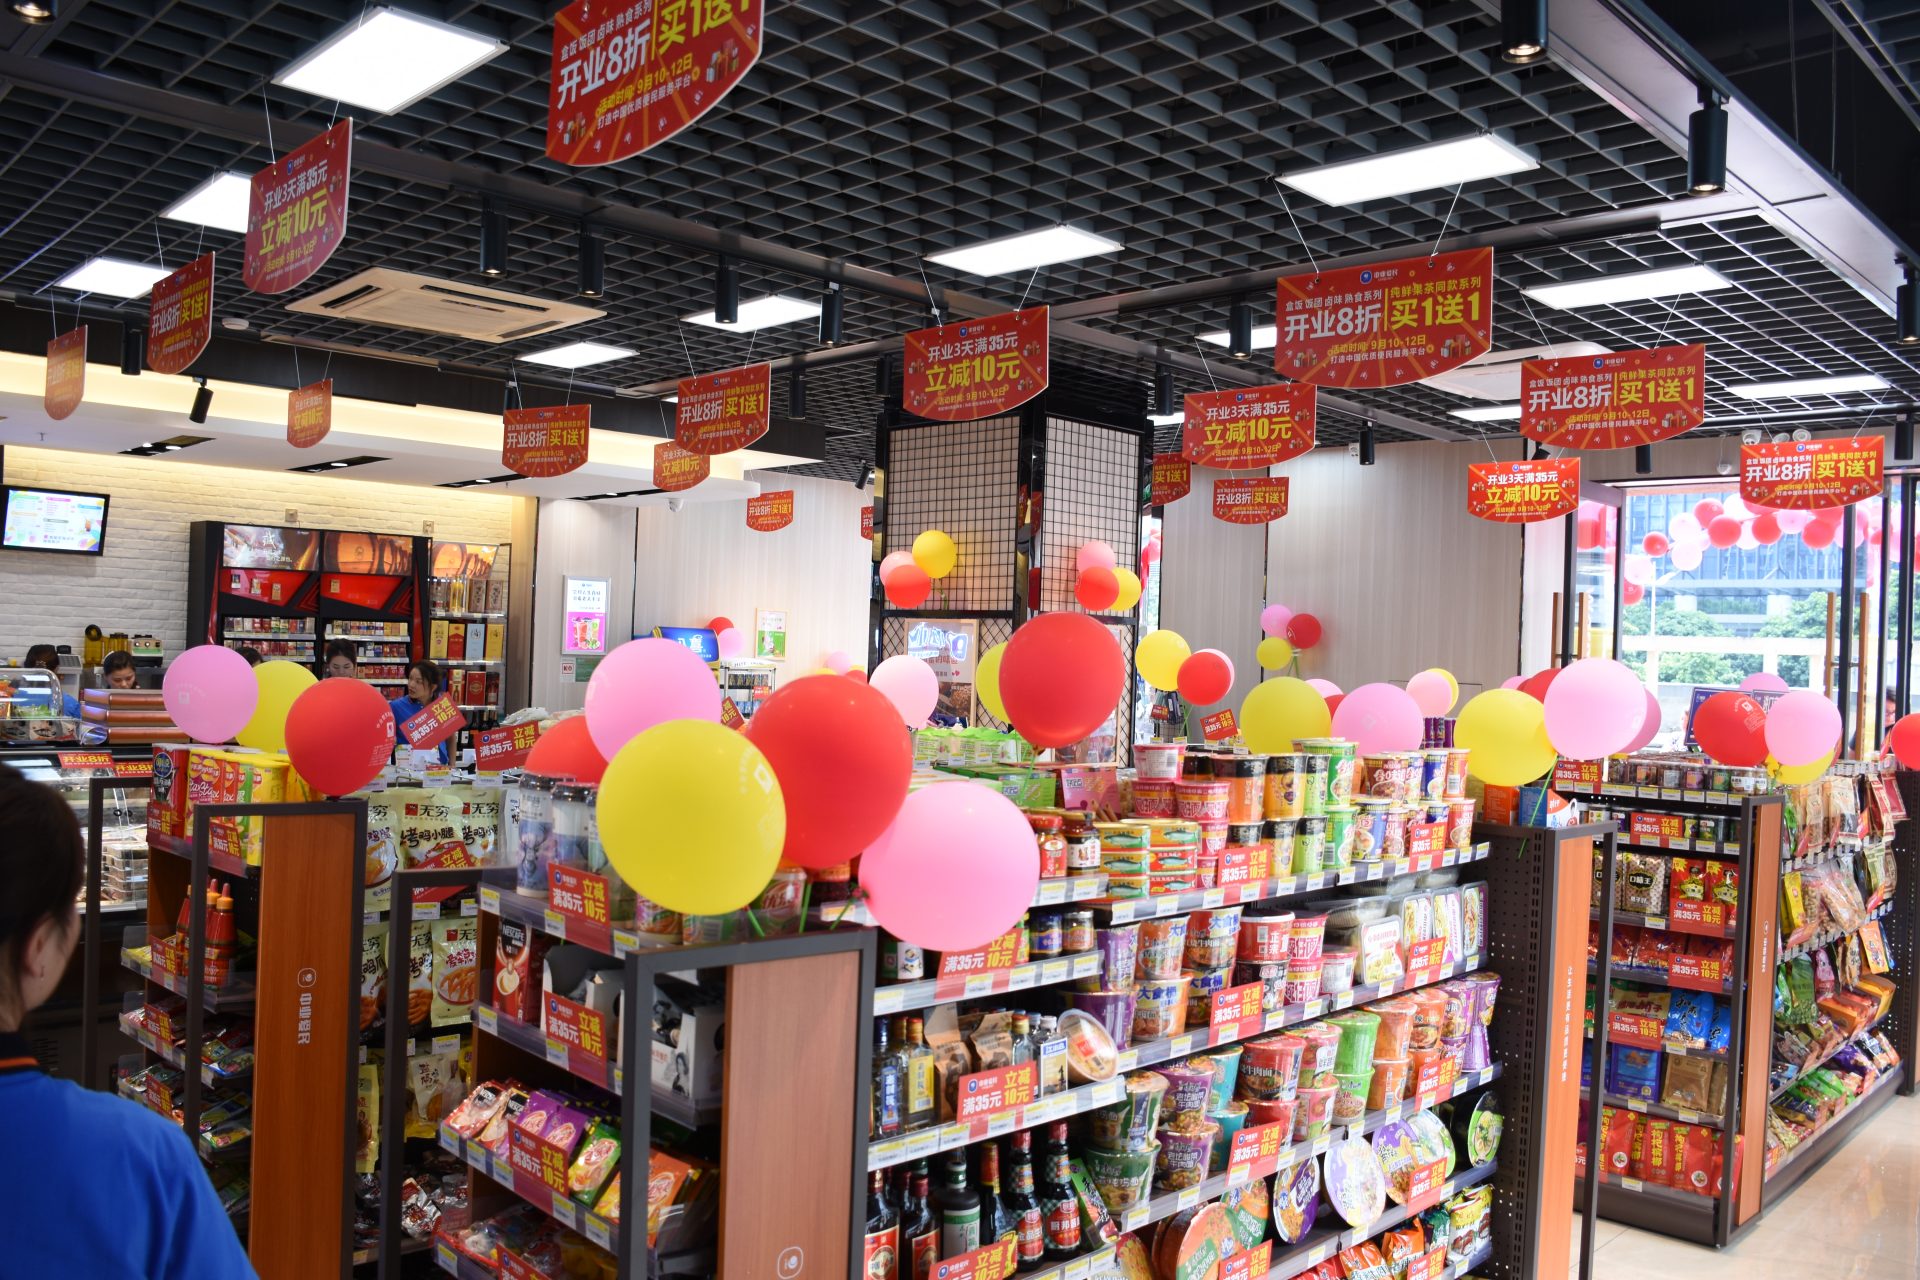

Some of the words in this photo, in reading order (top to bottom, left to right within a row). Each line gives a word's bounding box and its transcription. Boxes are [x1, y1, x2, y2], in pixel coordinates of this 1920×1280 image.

[561, 41, 577, 62] 盒饭
[579, 30, 595, 50] 饭团
[597, 20, 614, 40] 卤味
[557, 19, 651, 110] 开业8折
[637, 53, 693, 94] 9月10-12日
[597, 75, 691, 130] 打造中国优质便民服务平台
[264, 159, 328, 215] 开业3天满35元
[259, 188, 328, 256] 立减10元
[1390, 276, 1481, 298] 纯鲜果茶同款系列
[182, 291, 208, 325] 买1送1
[1285, 299, 1303, 311] 盒饭
[1305, 296, 1322, 308] 饭团
[1324, 294, 1343, 307] 卤味
[1344, 289, 1382, 304] 熟食系列
[1391, 292, 1480, 331] 买1送1
[152, 304, 180, 337] 开业8折
[1284, 303, 1382, 343] 开业8折
[928, 332, 1018, 362] 开业3天满35元
[1371, 335, 1426, 350] 9月10-12日
[1330, 348, 1425, 364] 打造中国优质便民服务平台
[925, 352, 1020, 393] 立减10元
[1529, 378, 1545, 388] 盒饭
[1546, 376, 1561, 386] 饭团
[1563, 375, 1578, 386] 卤味
[1580, 373, 1612, 383] 熟食系列
[1619, 365, 1696, 381] 纯鲜果茶同款系列
[966, 387, 1005, 401] 9月10-12日
[1528, 383, 1612, 413] 开业8折
[1620, 377, 1694, 404] 买1送1
[680, 400, 723, 425] 开业8折
[726, 393, 764, 417] 买1送1
[1206, 400, 1290, 421] 开业3天满35元
[1603, 409, 1649, 418] 9月10-12日
[1203, 416, 1292, 445] 立减10元
[1568, 419, 1649, 430] 打造中国优质便民服务平台
[507, 431, 547, 448] 开业8折
[550, 429, 585, 446] 买1送1
[662, 456, 700, 476] 立减10元
[1745, 462, 1811, 482] 开业8折
[1817, 459, 1876, 478] 买1送1
[1155, 469, 1187, 483] 买1送1
[1487, 471, 1558, 485] 开业3天满35元
[1216, 492, 1251, 505] 开业8折
[1254, 492, 1285, 504] 买1送1
[1485, 484, 1559, 504] 立减10元
[749, 505, 771, 516] 开业8折
[772, 504, 791, 514] 买1送1
[432, 697, 451, 716] 立减
[437, 707, 457, 723] 10元
[411, 719, 438, 742] 满35元
[514, 724, 535, 739] 立减
[480, 741, 512, 757] 满35元
[516, 737, 535, 749] 10元
[1556, 769, 1580, 780] 满35元
[1581, 764, 1598, 774] 立减
[1582, 772, 1598, 782] 10元
[420, 804, 450, 817] 无穷
[1634, 823, 1659, 834] 满35元
[1661, 817, 1679, 828] 立减
[1662, 826, 1680, 836] 10元
[1432, 825, 1445, 840] 立减
[1412, 838, 1431, 851] 满35元
[1431, 838, 1442, 851] 10元
[441, 847, 464, 866] 立减
[1249, 850, 1267, 865] 立减
[1221, 866, 1248, 881] 满35元
[1249, 864, 1266, 878] 10元
[583, 879, 604, 899] 立减
[1630, 876, 1651, 885] 口味王
[553, 888, 583, 913] 满35元
[583, 898, 606, 922] 10元
[1674, 909, 1701, 920] 满35元
[1703, 905, 1721, 914] 立减
[1703, 913, 1721, 924] 10元
[989, 932, 1017, 952] 立减
[1430, 940, 1443, 954] 立减
[944, 952, 985, 973] 满35元
[987, 951, 1013, 968] 10元
[1701, 961, 1720, 971] 立减
[1672, 965, 1699, 976] 满35元
[1701, 969, 1720, 980] 10元
[1242, 986, 1261, 1003] 立减
[1214, 1005, 1240, 1024] 满35元
[1242, 1000, 1259, 1016] 10元
[549, 1016, 579, 1044] 满35元
[578, 1011, 601, 1034] 立减
[1613, 1022, 1638, 1034] 满35元
[1640, 1019, 1657, 1029] 立减
[1640, 1028, 1657, 1038] 10元
[581, 1031, 602, 1056] 10元
[1004, 1068, 1031, 1088] 立减
[963, 1091, 1002, 1116] 满35元
[1004, 1086, 1029, 1106] 10元
[1261, 1126, 1280, 1144] 立减
[1232, 1143, 1259, 1163] 满35元
[1260, 1142, 1277, 1156] 10元
[512, 1145, 542, 1177] 满35元
[541, 1145, 564, 1171] 立减
[1432, 1161, 1445, 1175] 立减
[543, 1166, 565, 1193] 10元
[976, 1244, 1003, 1267] 立减
[1251, 1245, 1268, 1265] 立减
[1430, 1250, 1443, 1262] 立减
[1250, 1262, 1266, 1278] 10元
